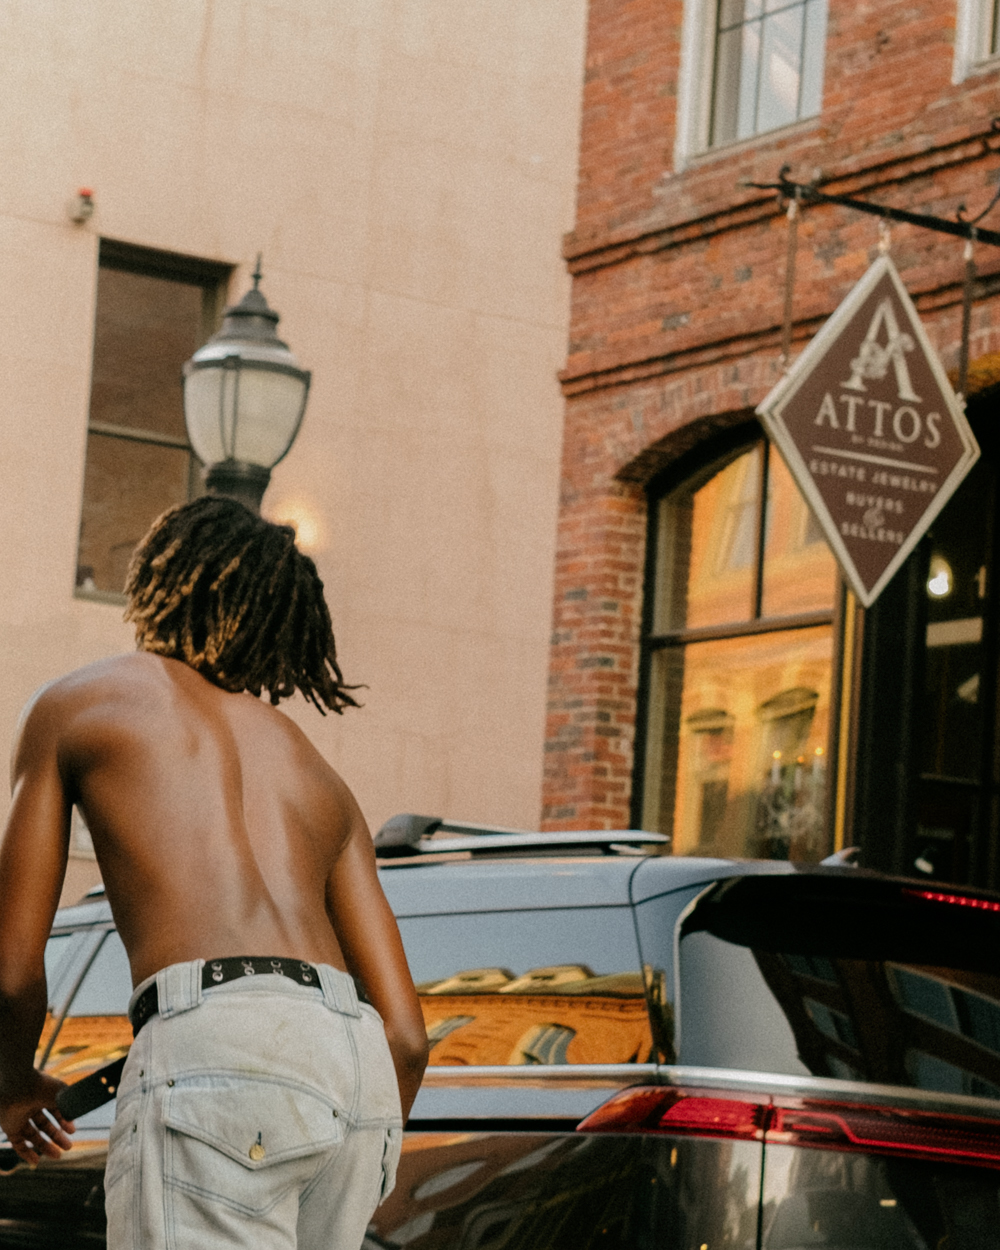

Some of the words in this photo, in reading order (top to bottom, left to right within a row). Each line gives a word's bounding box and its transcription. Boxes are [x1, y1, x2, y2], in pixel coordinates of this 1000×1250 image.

[815, 392, 941, 448] ATTOS
[810, 458, 867, 482] ESTATE
[872, 470, 938, 494] JEWELRY
[846, 491, 904, 514] BUYERS
[841, 520, 904, 545] SELLERS
